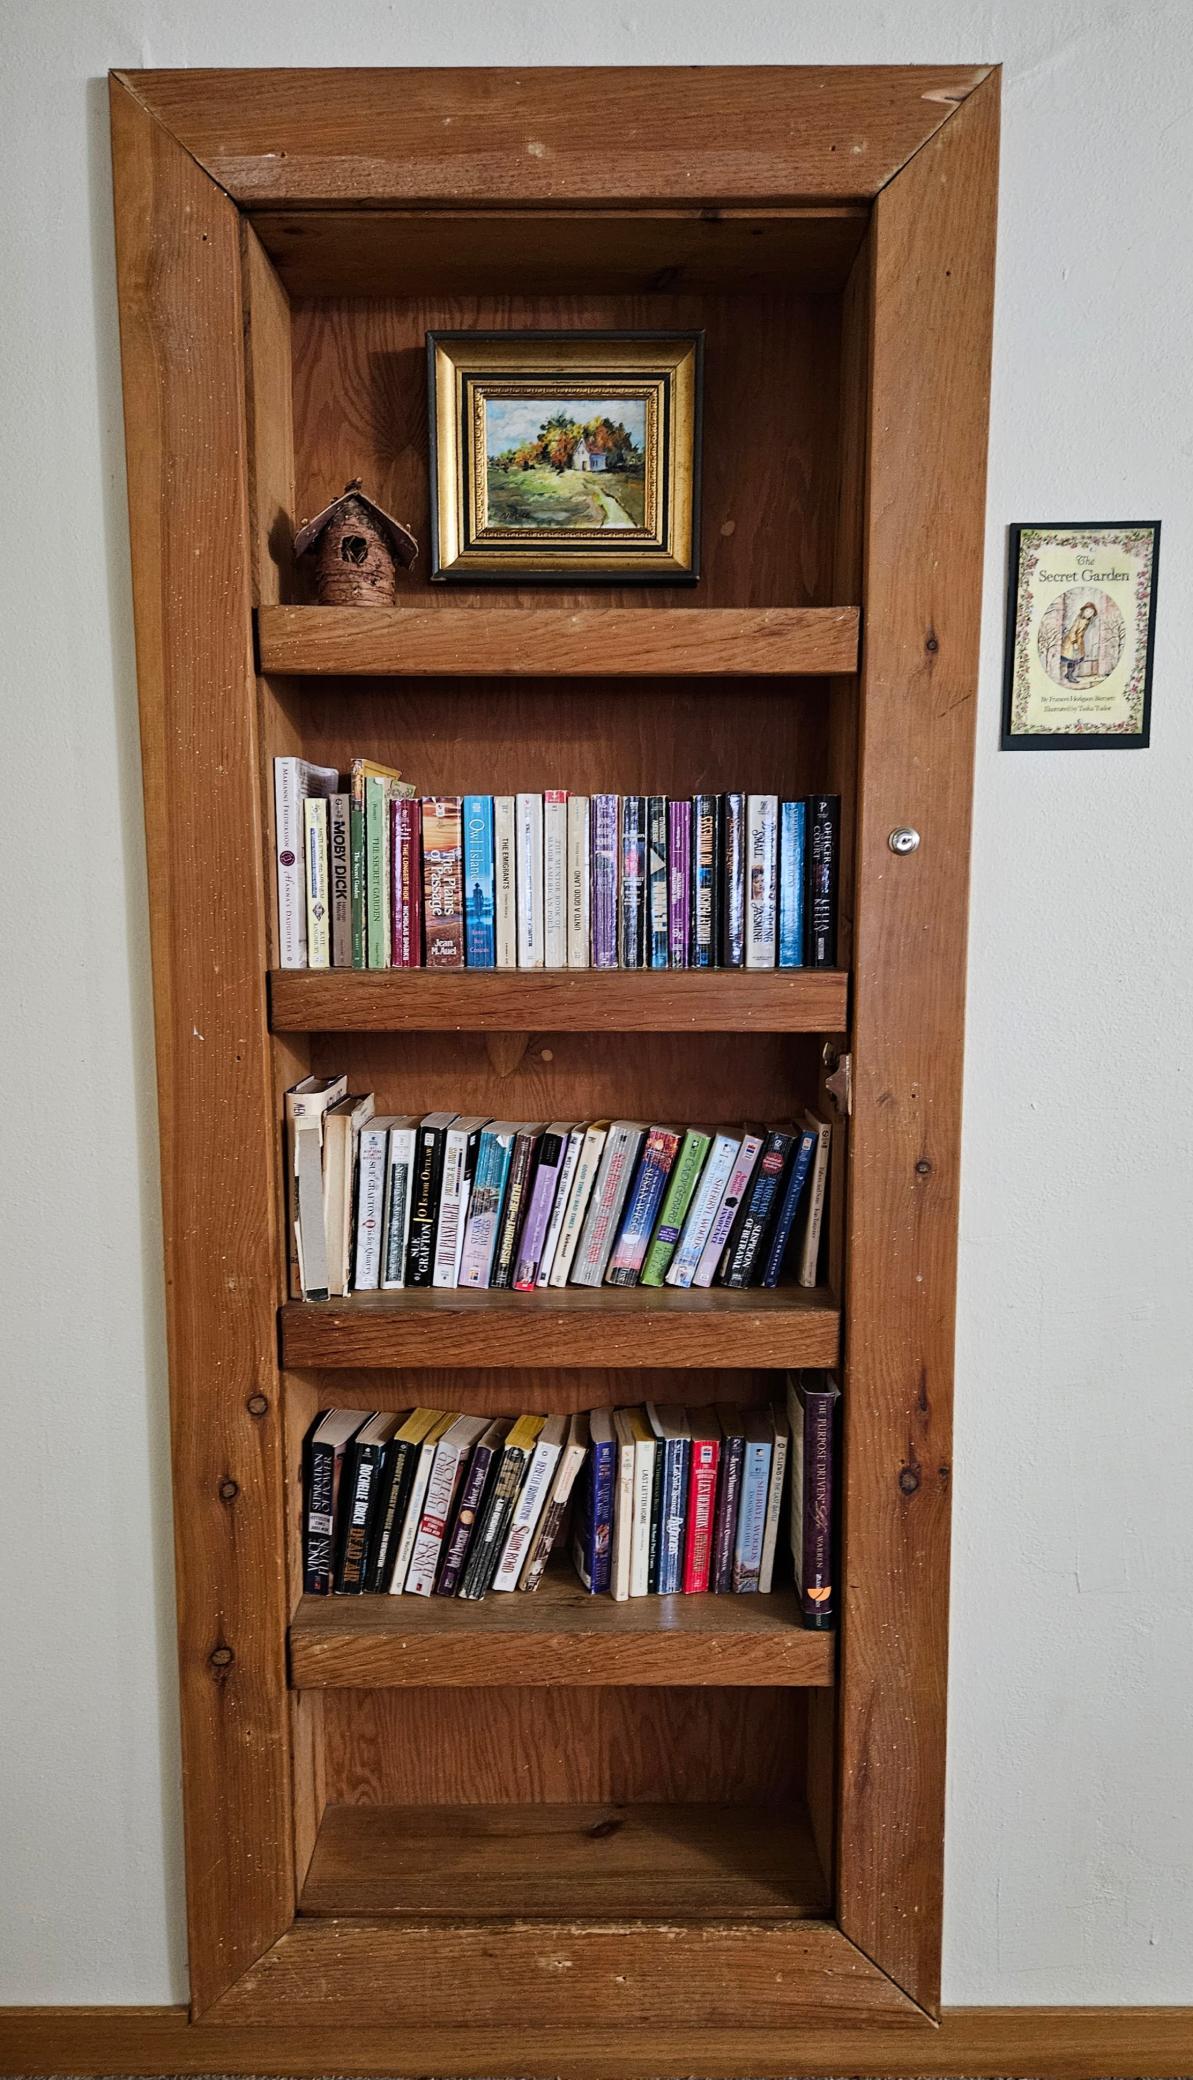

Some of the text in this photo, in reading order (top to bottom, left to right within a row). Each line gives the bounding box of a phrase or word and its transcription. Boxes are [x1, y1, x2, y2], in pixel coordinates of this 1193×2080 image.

[1039, 569, 1129, 582] Secret Garden
[334, 821, 346, 862] MOBY
[469, 819, 484, 881] Owl Island
[698, 816, 712, 864] NO WITNESSES
[753, 829, 764, 858] SMALL
[812, 826, 820, 859] COURT
[824, 822, 832, 863] OFFICER
[335, 865, 347, 899] DICK
[429, 850, 443, 916] of Passage
[443, 852, 456, 915] The Plains
[697, 888, 712, 937] RIDLEY PEARSON
[752, 902, 763, 943] JASMINE
[434, 939, 454, 947] Jean
[368, 1161, 376, 1178] SUE
[559, 1157, 572, 1196] WEST STORY
[639, 1168, 654, 1199] SUSAN
[729, 1170, 742, 1196] Christie
[736, 1174, 748, 1196] Agatha
[367, 1180, 376, 1217] GRAFTON
[668, 1158, 694, 1224] CINDY GERARD
[749, 1178, 765, 1213] PARKER
[757, 1177, 776, 1218] BARBARA
[362, 1219, 376, 1229] Q
[471, 1218, 481, 1245] SUSAN
[480, 1219, 491, 1246] WIGGS
[500, 1184, 522, 1264] DISCOUNT DEATH
[629, 1200, 645, 1235] WIGGS
[693, 1177, 724, 1251] SHERRYL WOODS
[411, 1237, 421, 1257] SUE
[419, 1224, 432, 1272] GRAFTON
[438, 1204, 460, 1267] THE PASSENGER
[561, 1233, 572, 1258] Kirkwood
[732, 1218, 754, 1270] OF BETRAYAL
[742, 1224, 762, 1268] SUSPICION
[364, 1247, 374, 1276] Quarry
[432, 1451, 448, 1486] THIRD
[816, 1400, 828, 1501] THE PURPOSE DRIVEN
[312, 1453, 323, 1510] SEPARATION
[322, 1456, 332, 1496] POWER
[352, 1464, 374, 1524] ROCHELLE KRICH
[436, 1454, 457, 1514] OPTION
[697, 1480, 711, 1494] LEN
[485, 1499, 505, 1542] LEN DEIGHTON
[696, 1494, 710, 1528] DEIGHTON
[750, 1480, 766, 1561] SHERRYL WOODS
[307, 1538, 319, 1572] VINCE
[318, 1538, 330, 1576] FLYNN
[344, 1528, 365, 1584] DEAD AIR
[411, 1539, 425, 1572] VINCE
[422, 1542, 439, 1579] FLYNN
[501, 1525, 530, 1573] SWAN ROAD
[816, 1535, 824, 1568] WARREN
